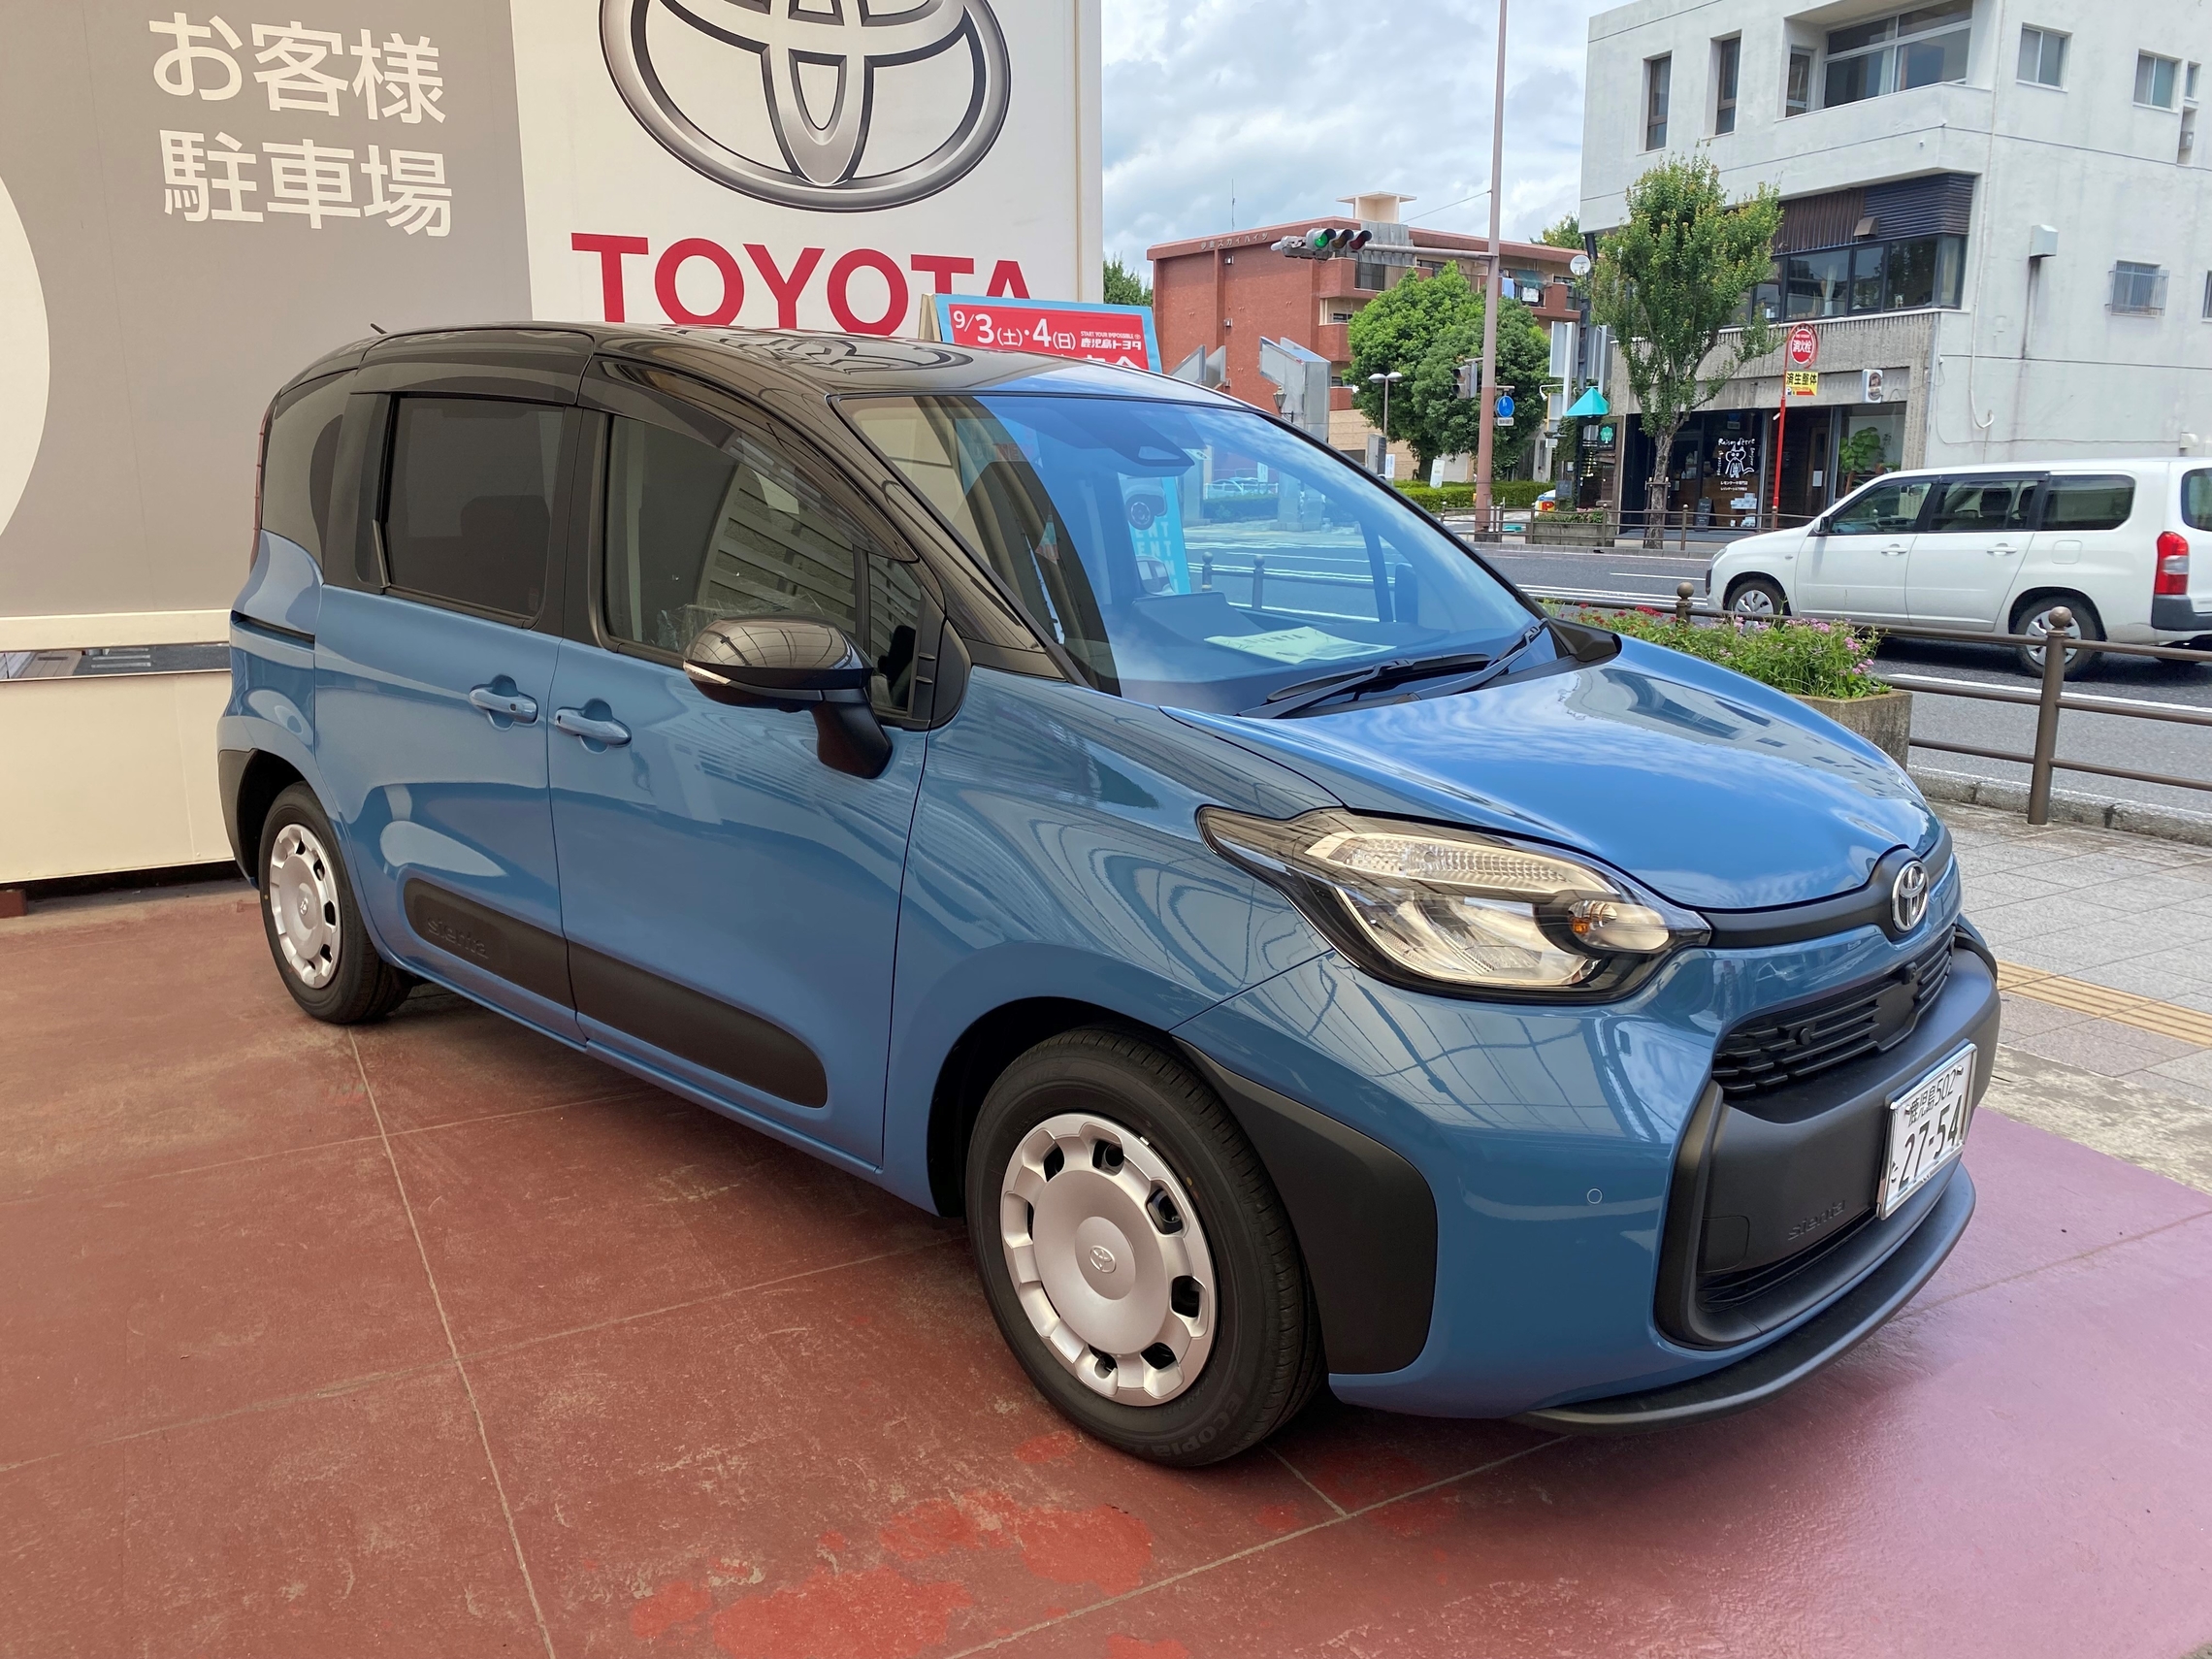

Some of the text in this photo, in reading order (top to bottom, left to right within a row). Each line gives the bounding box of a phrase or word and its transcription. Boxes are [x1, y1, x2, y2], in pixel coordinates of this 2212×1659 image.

[148, 12, 446, 125] お客様
[158, 129, 453, 238] 駐車場
[1080, 338, 1142, 350] 鹿児島トヨタ
[1792, 340, 1812, 353] 消火栓
[1899, 1093, 1963, 1192] 27-54
